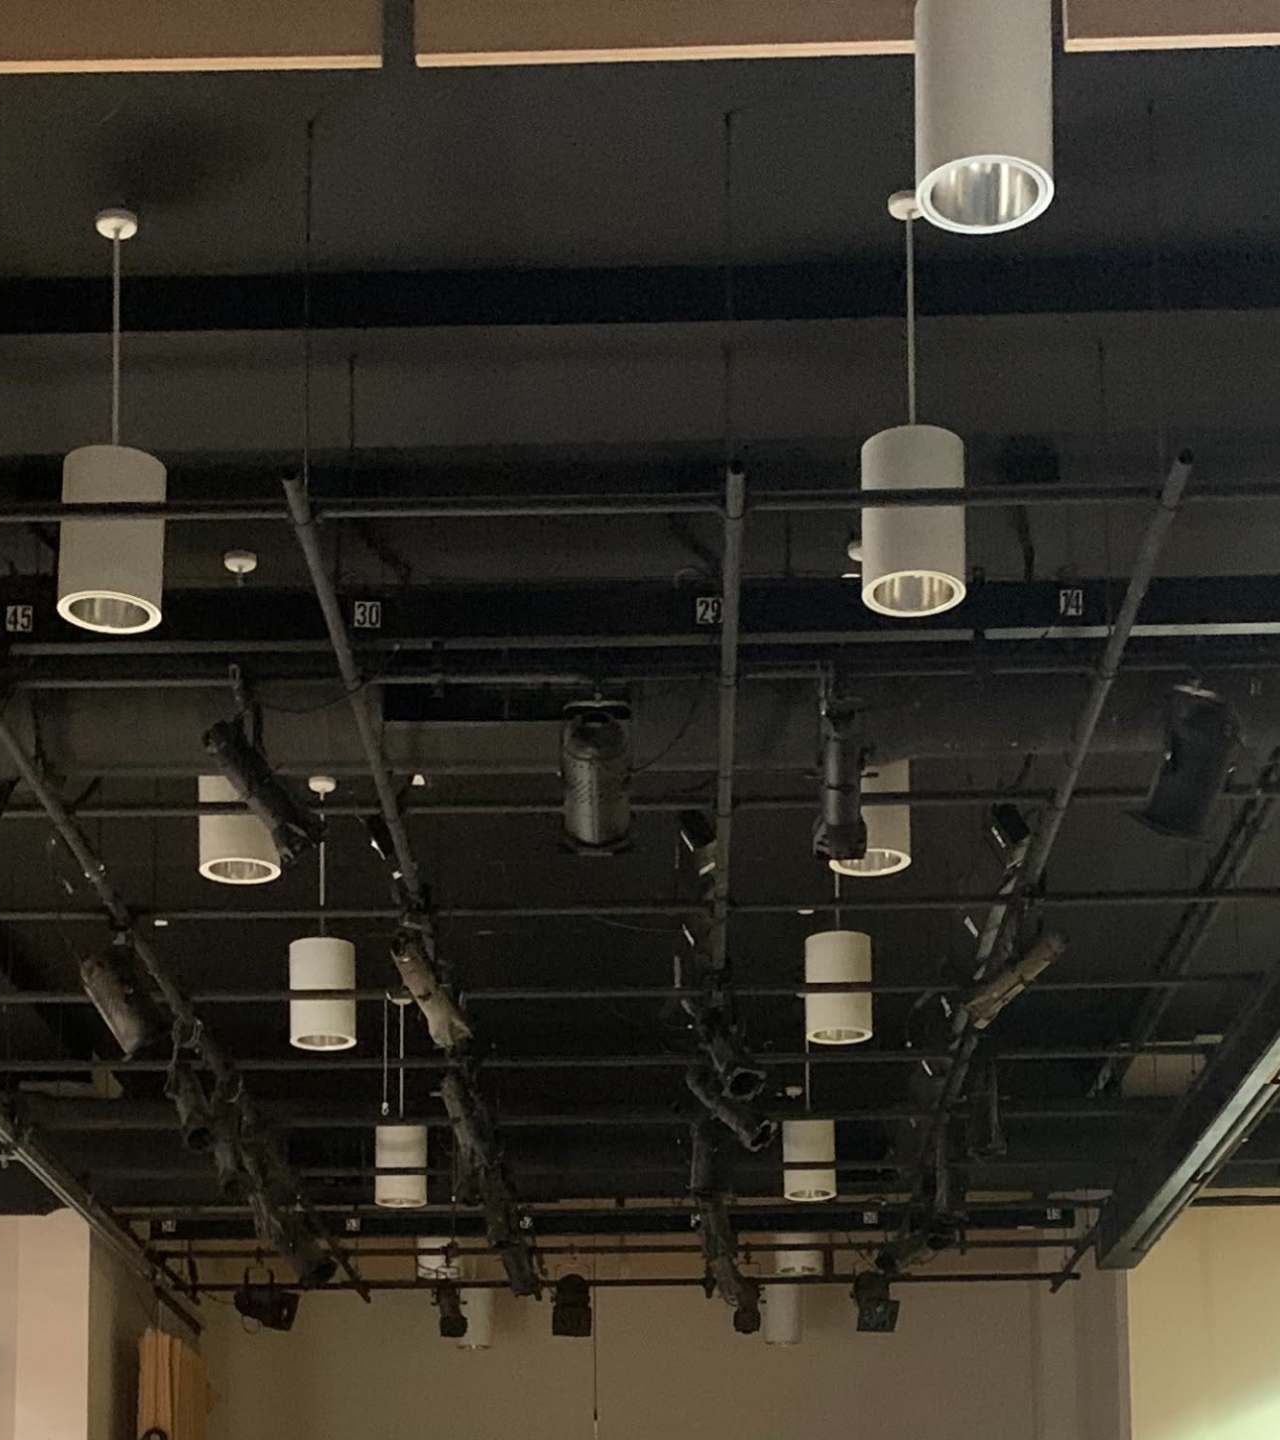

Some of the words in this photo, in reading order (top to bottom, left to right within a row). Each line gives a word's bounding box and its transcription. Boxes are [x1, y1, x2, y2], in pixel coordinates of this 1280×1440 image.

[7, 606, 32, 630] 45
[356, 603, 380, 626] 30
[699, 600, 722, 622] 29
